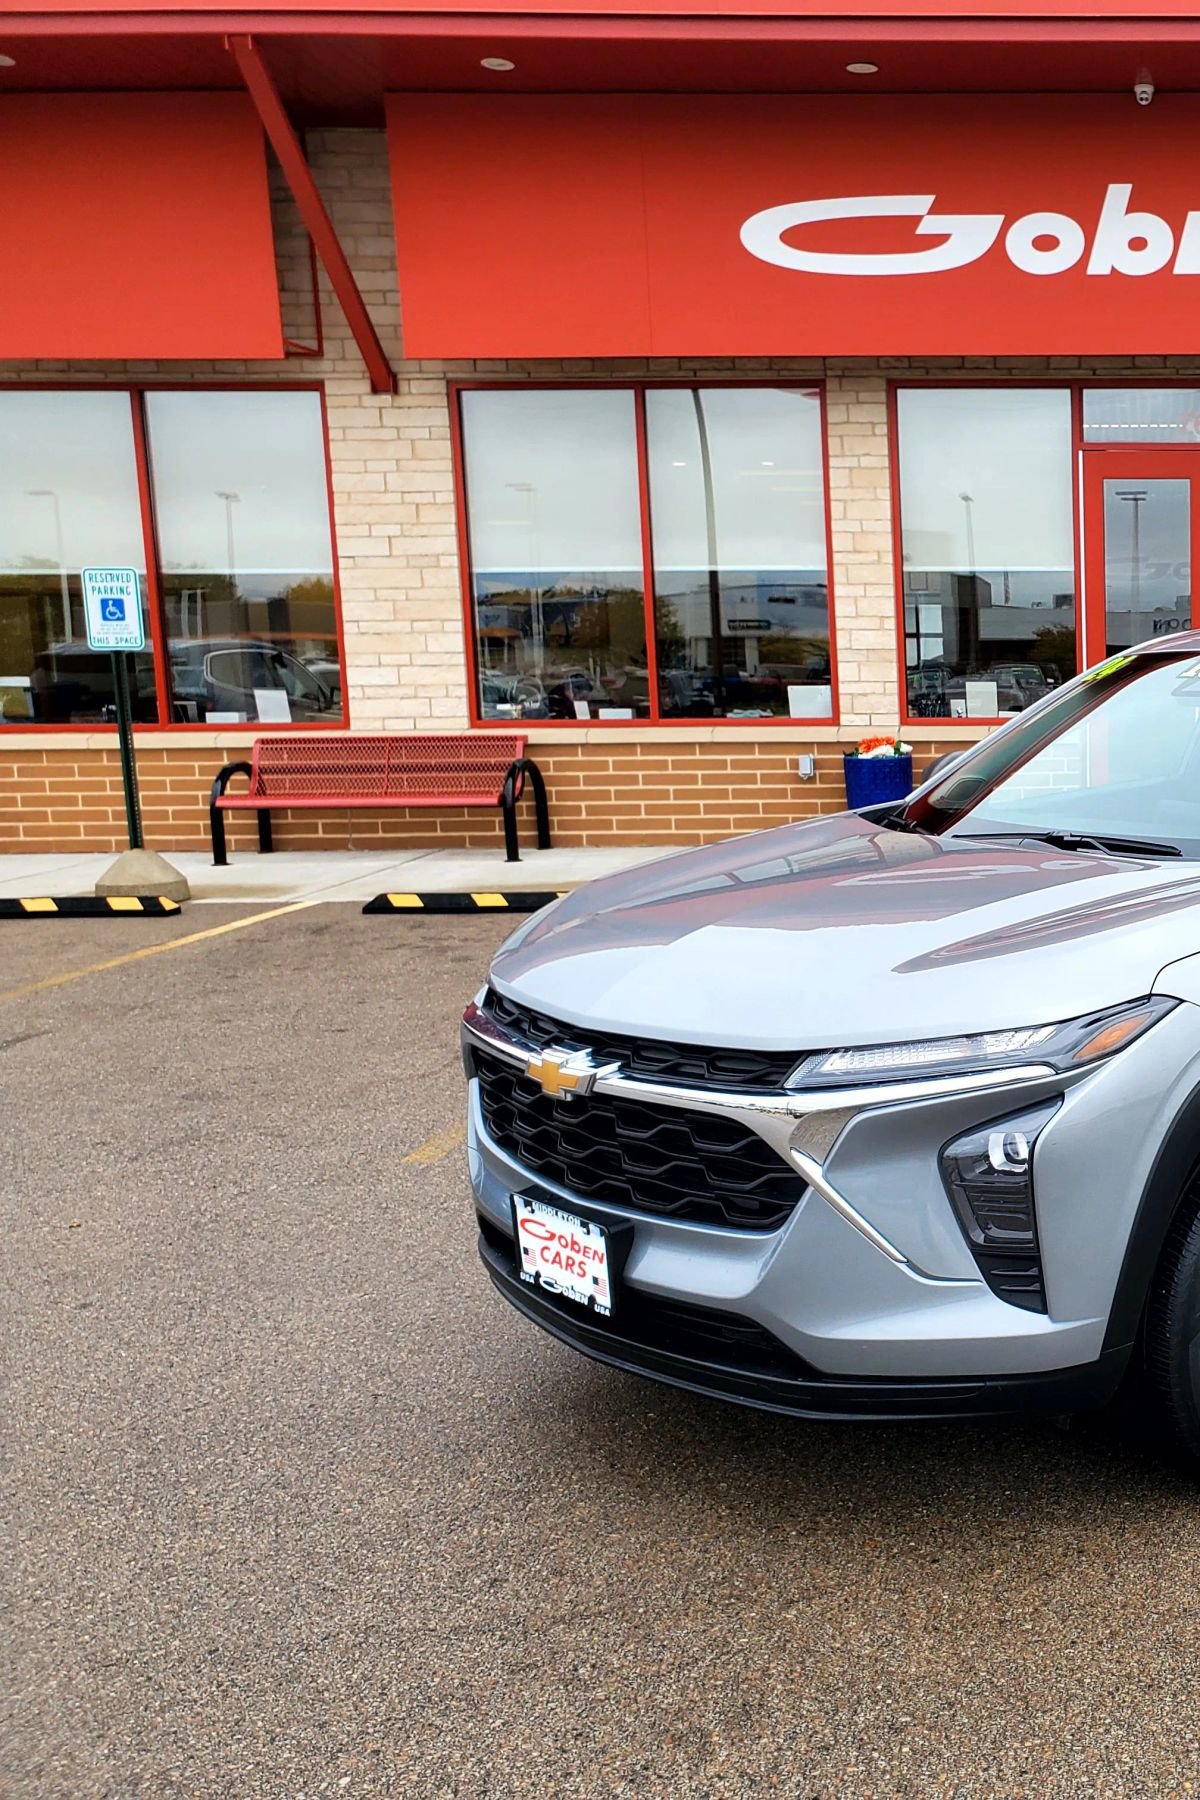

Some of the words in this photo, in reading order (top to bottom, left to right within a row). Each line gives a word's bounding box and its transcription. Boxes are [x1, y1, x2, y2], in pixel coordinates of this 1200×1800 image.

[88, 572, 131, 583] RESERVED
[91, 585, 131, 596] PARKING
[92, 636, 110, 645] THIS
[114, 636, 139, 645] SPACE
[540, 1246, 587, 1278] CARS
[520, 1271, 535, 1284] USA
[594, 1303, 611, 1317] USA
